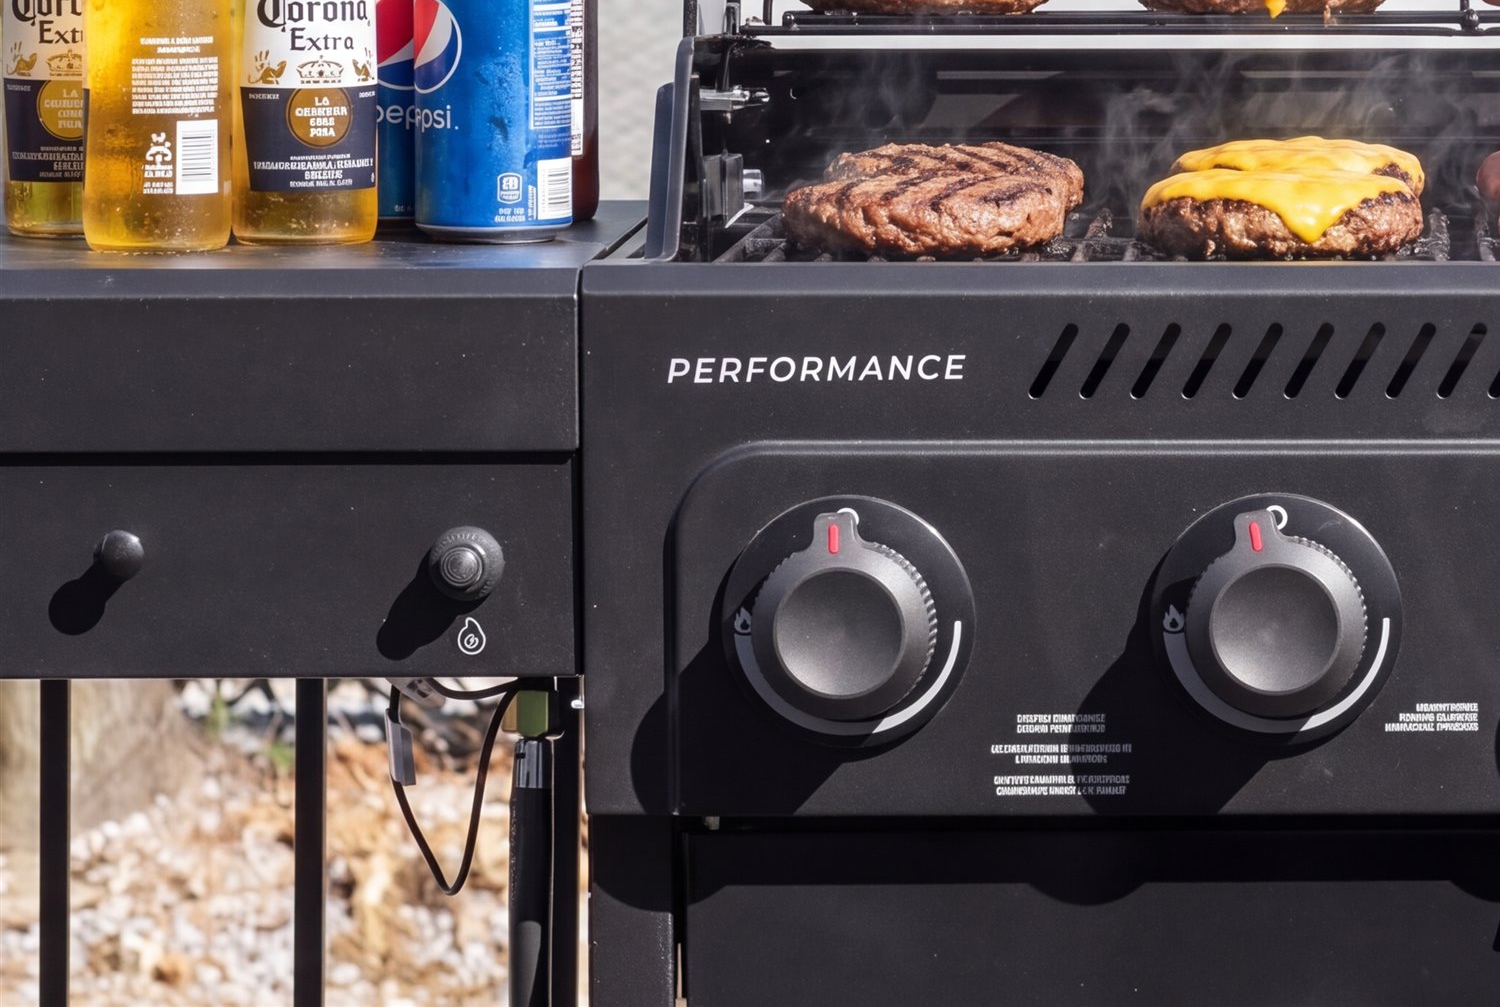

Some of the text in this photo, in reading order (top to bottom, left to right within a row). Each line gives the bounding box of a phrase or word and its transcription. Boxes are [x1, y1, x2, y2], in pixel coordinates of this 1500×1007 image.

[39, 20, 83, 44] Ext
[290, 27, 354, 51] Extra
[667, 354, 966, 384] PERFORMANCE
